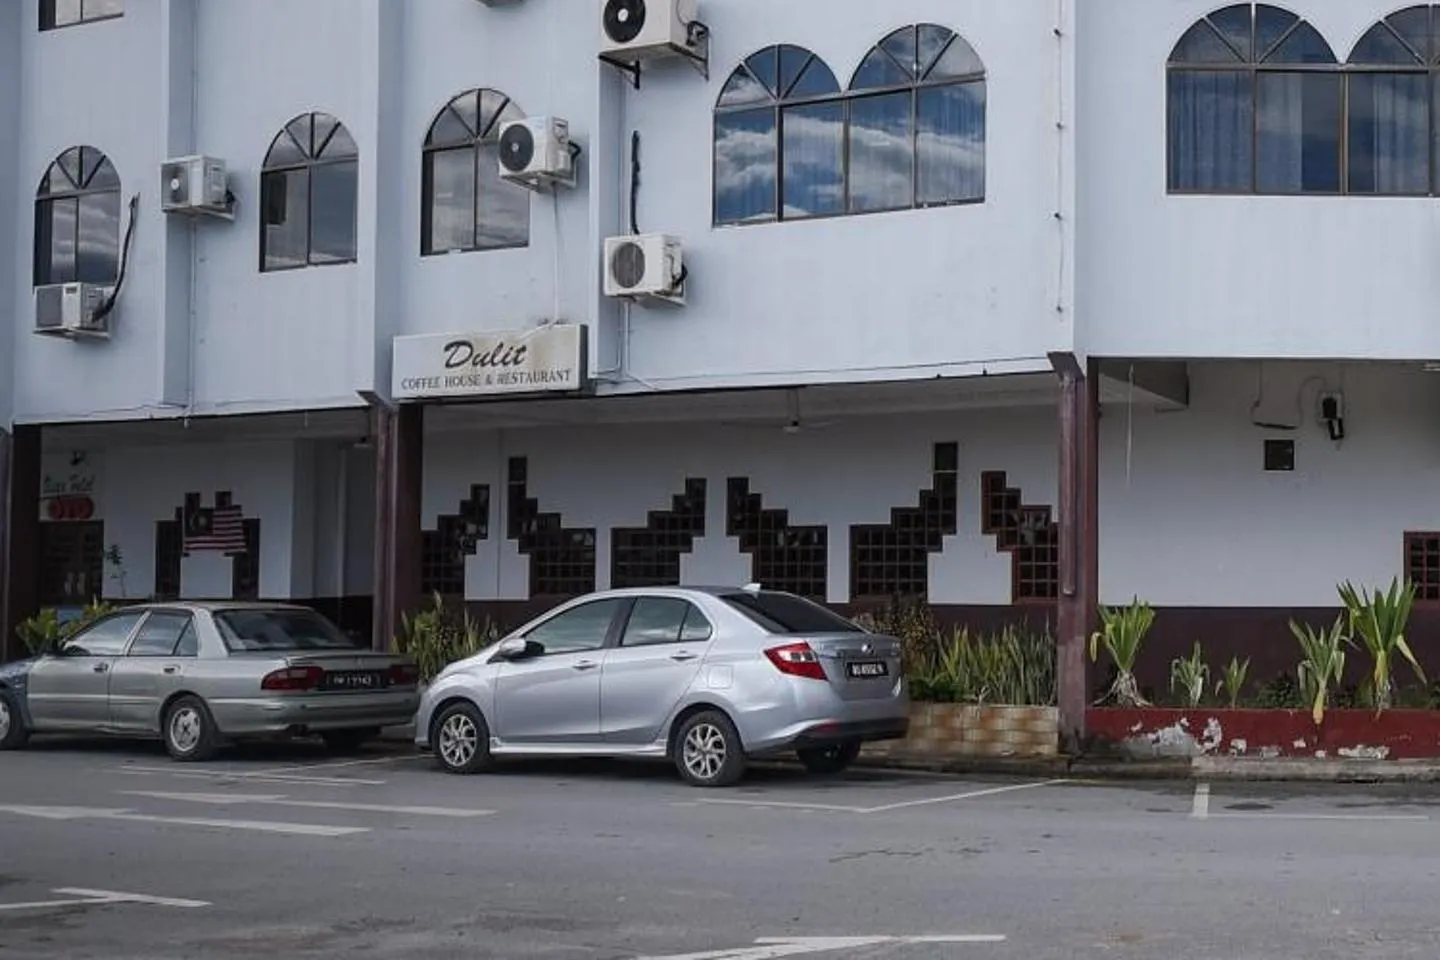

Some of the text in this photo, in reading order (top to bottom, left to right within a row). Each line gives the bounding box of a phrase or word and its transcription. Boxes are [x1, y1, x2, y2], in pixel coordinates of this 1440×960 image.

[443, 340, 527, 369] Dulit
[400, 368, 572, 391] COFFEE HOUSE & RESTAURANT
